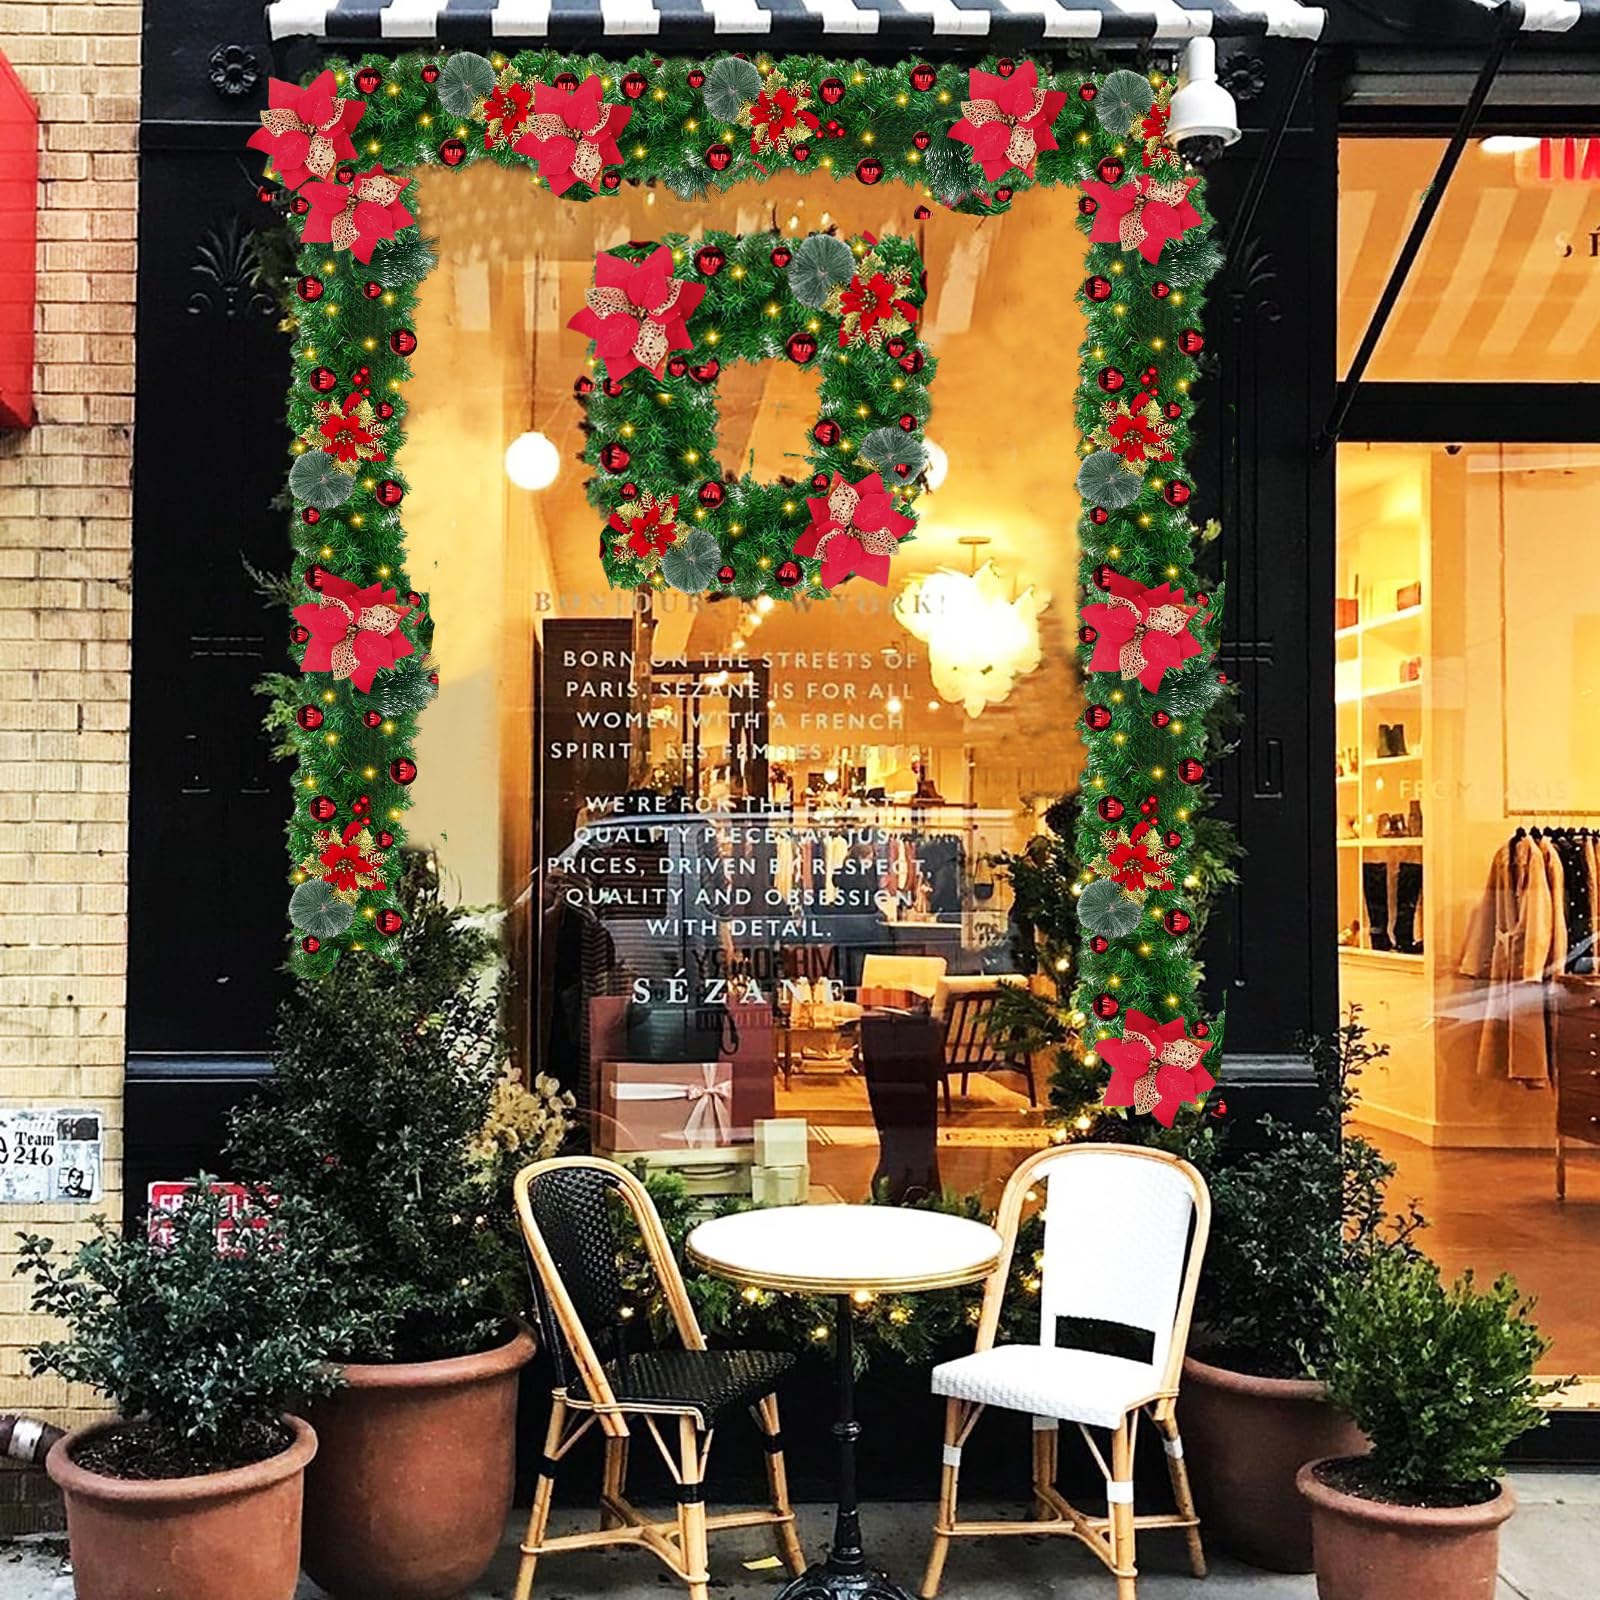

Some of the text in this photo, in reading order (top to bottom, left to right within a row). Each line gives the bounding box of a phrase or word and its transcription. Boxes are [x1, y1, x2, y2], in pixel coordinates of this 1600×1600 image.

[563, 650, 919, 669] BORN ON THE STREETS OF
[566, 681, 648, 700] PARIS,
[773, 683, 794, 699] IS
[807, 683, 856, 699] FOR
[868, 683, 914, 699] ALL
[576, 711, 903, 730] WOMEN WITH A FRENCH
[550, 742, 633, 759] SPIRIT
[666, 743, 708, 759] LES
[722, 743, 821, 760] FEMES
[680, 797, 731, 813] FOR
[742, 797, 790, 813] THE
[574, 827, 691, 845] QUALITY
[704, 827, 791, 844] PIECES
[547, 857, 645, 877] PRICES,
[659, 858, 756, 875] DRIVEN
[566, 888, 913, 907] QUALITY AND OBSESSION
[646, 919, 832, 937] WITH DETAIL.
[632, 968, 845, 1004] SÉZANE
[15, 1131, 55, 1147] Team
[13, 1146, 54, 1167] 246
